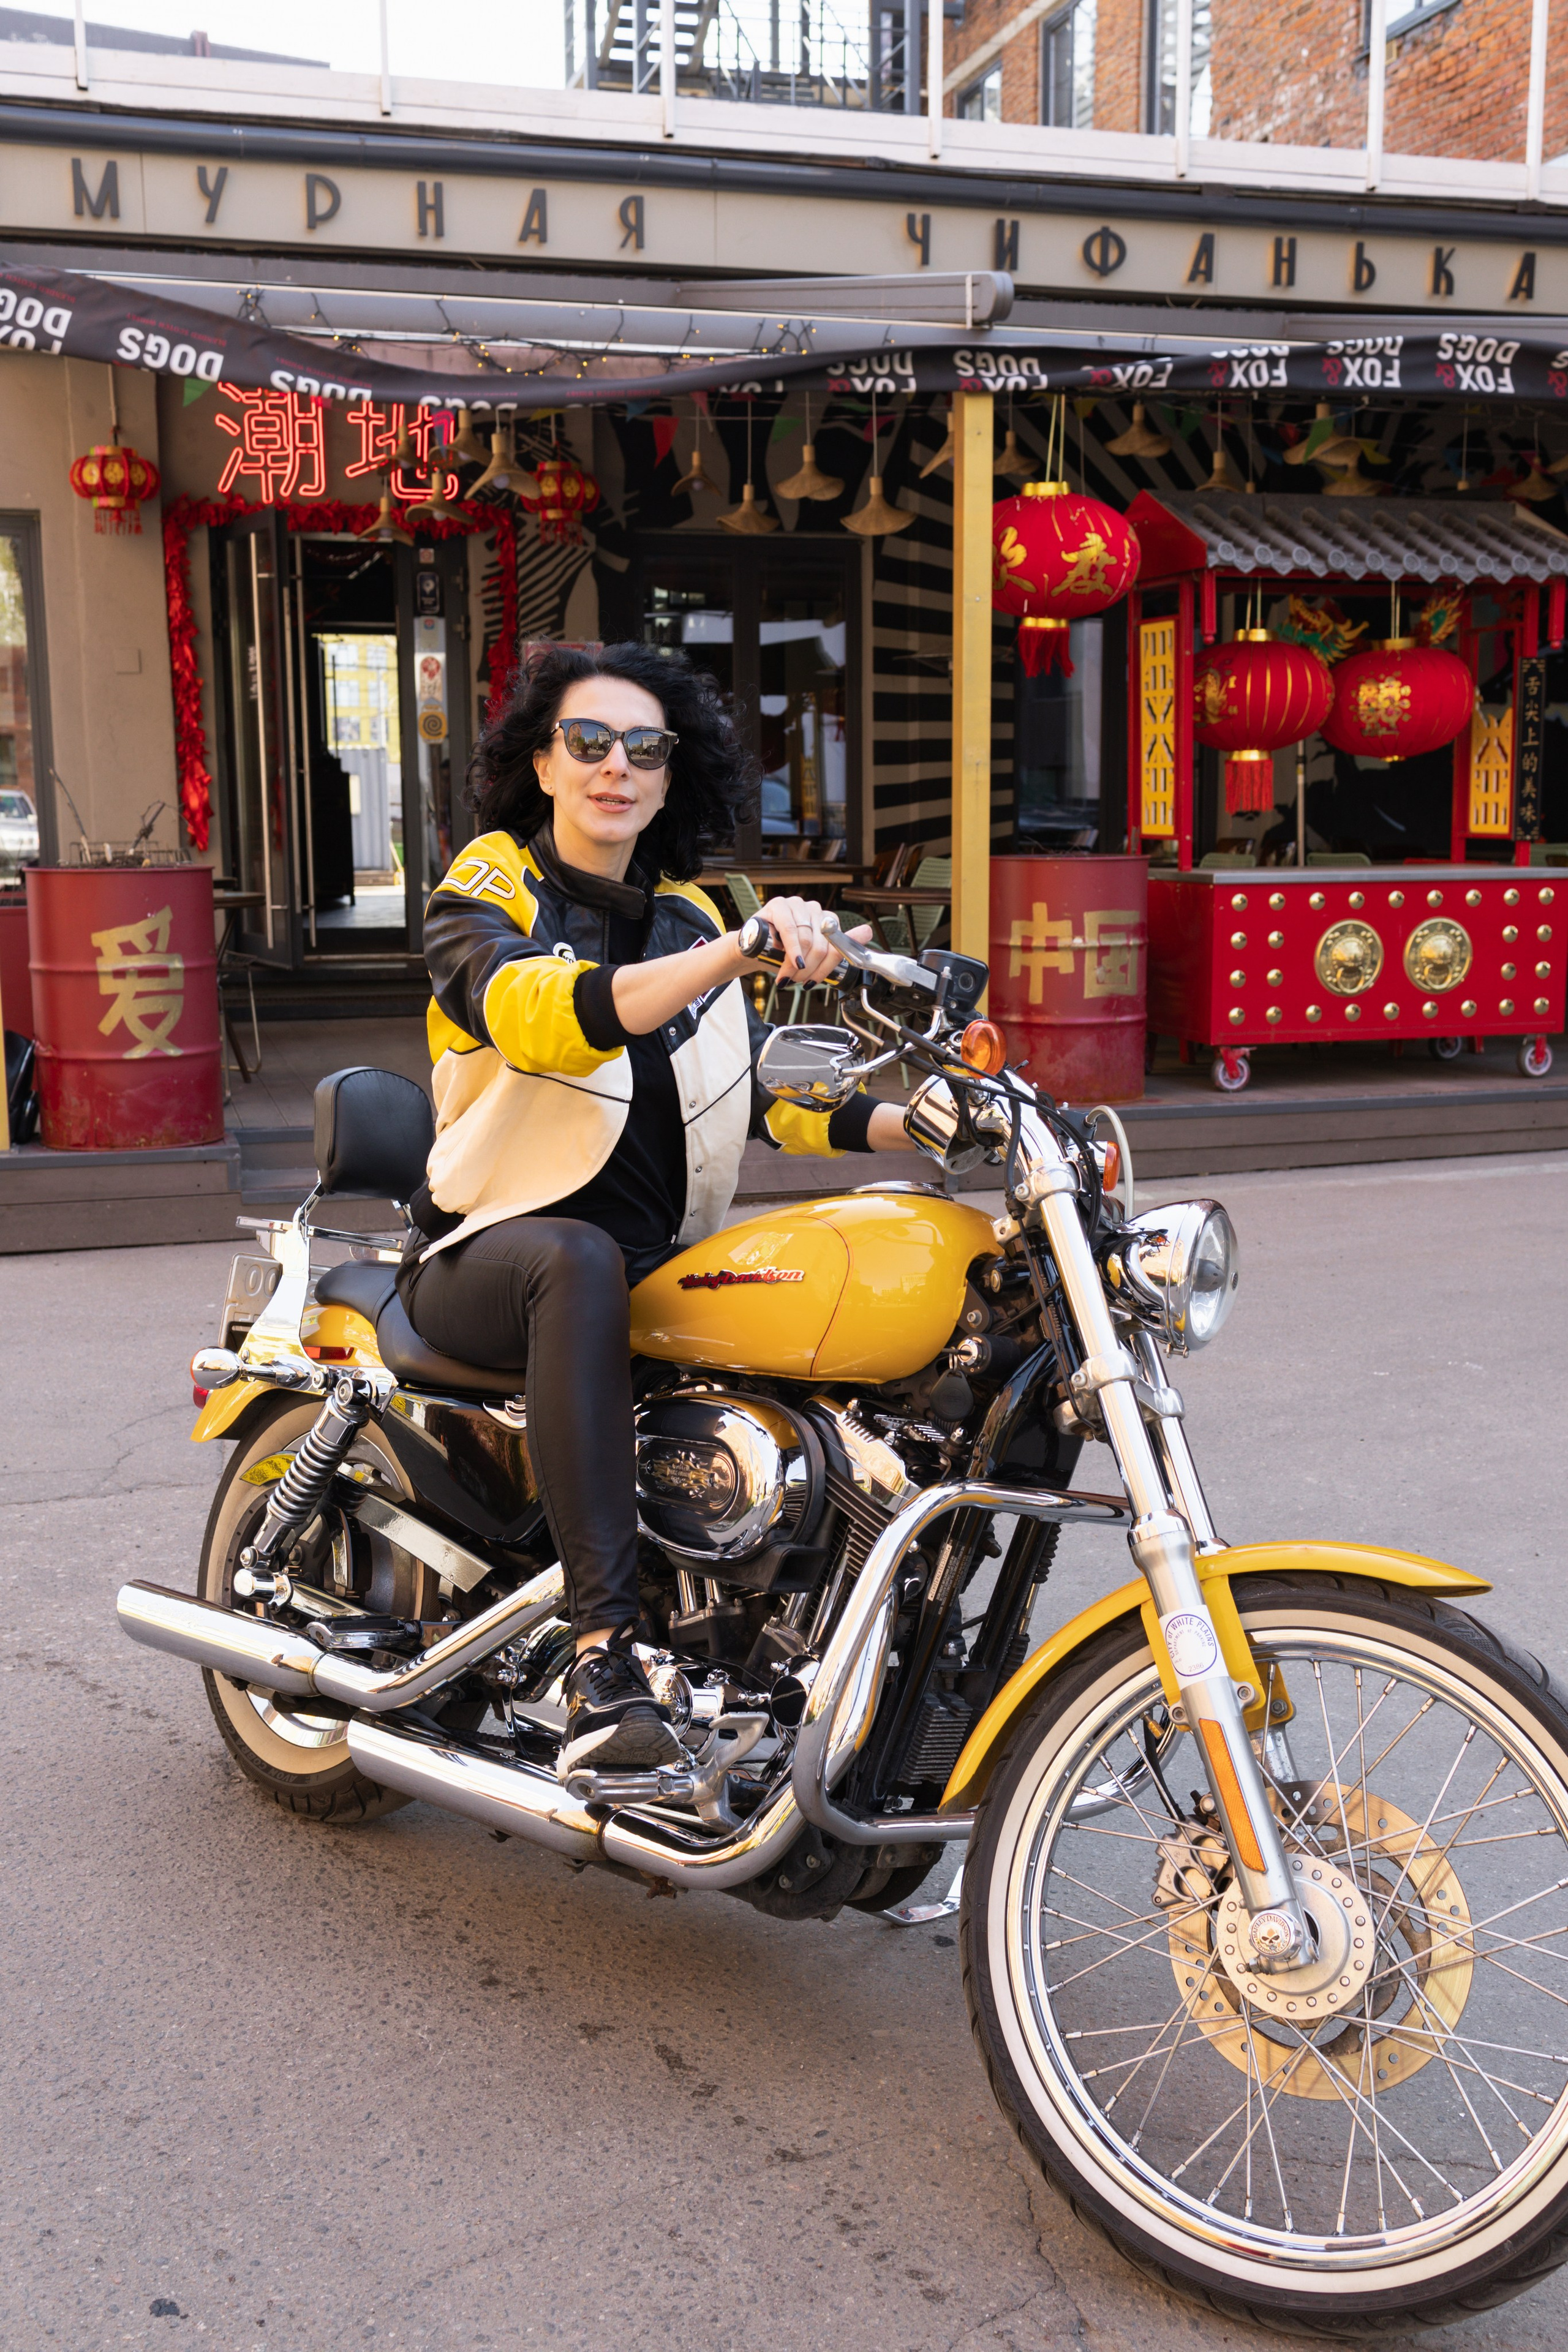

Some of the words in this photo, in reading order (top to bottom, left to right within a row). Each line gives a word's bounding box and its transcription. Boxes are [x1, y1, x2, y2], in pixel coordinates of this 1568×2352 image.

[71, 157, 645, 249] МУРНАЯ
[907, 213, 1536, 300] ЧИФАНЬКА
[116, 327, 224, 383] DOGS
[1436, 333, 1520, 364] DOGS
[1112, 363, 1173, 388] FOX
[1228, 358, 1288, 388] FOX
[1342, 357, 1401, 388] FOX
[1455, 363, 1515, 394] FOX
[1519, 676, 1542, 824] 舌尖上的美味
[1009, 902, 1141, 1005] 中国
[91, 905, 184, 1059] 爱
[1170, 1617, 1194, 1630] WHITE
[1196, 1621, 1214, 1647] PLAINS
[1188, 1662, 1204, 1672] 2386
